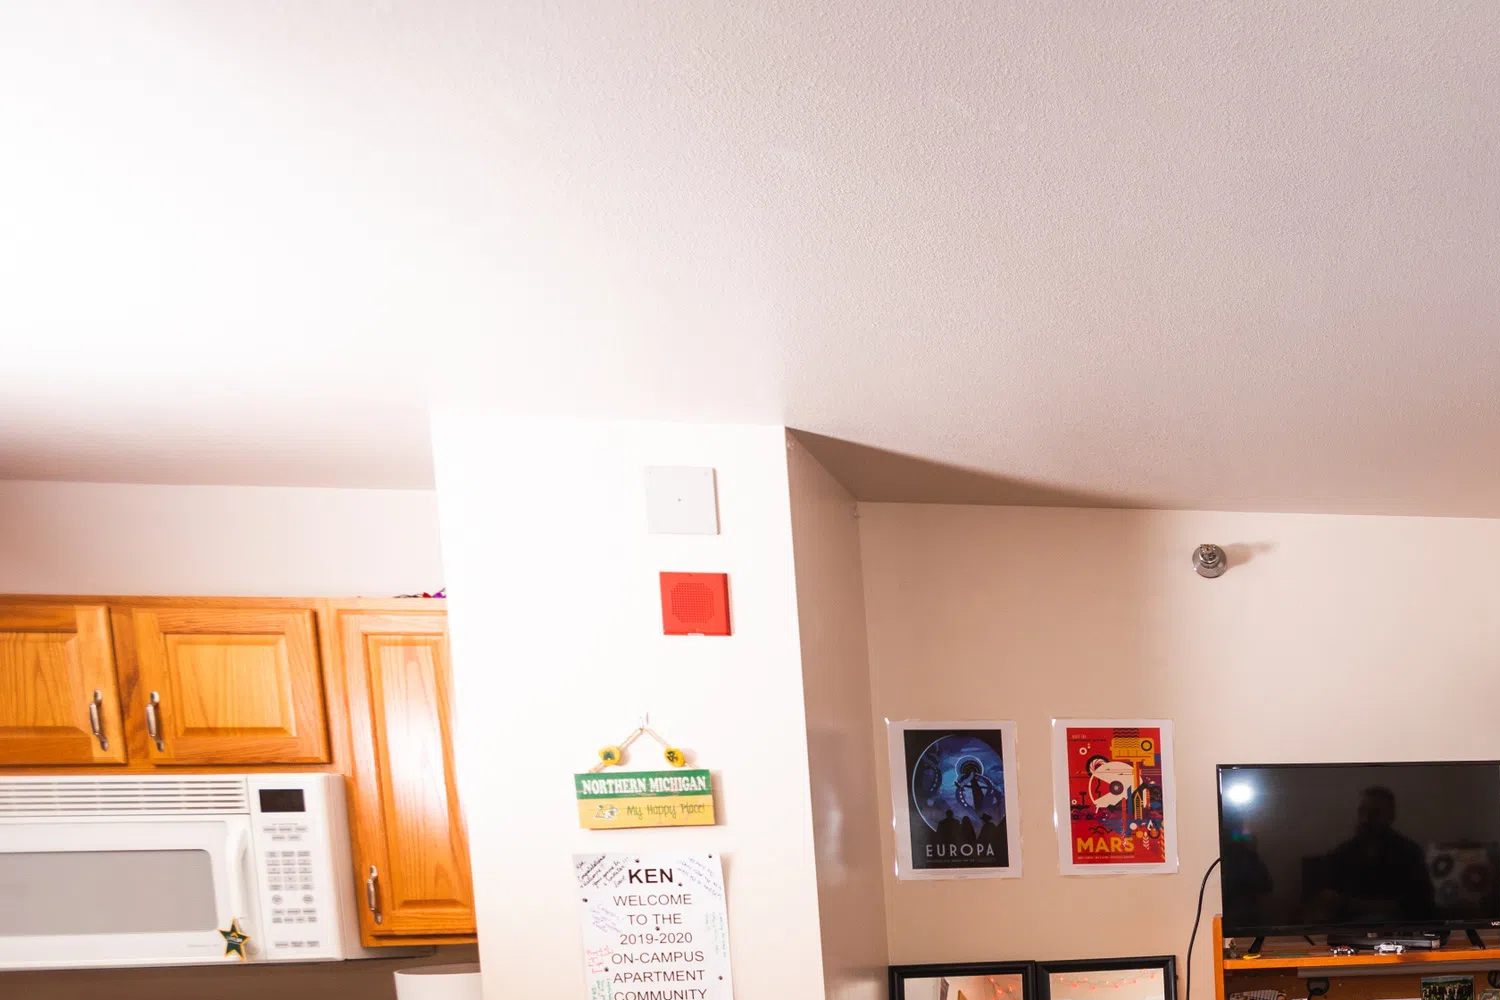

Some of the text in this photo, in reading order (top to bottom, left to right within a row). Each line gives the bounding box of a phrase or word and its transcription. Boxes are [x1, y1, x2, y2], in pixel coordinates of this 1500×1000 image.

[581, 775, 707, 795] NORTHERN MICHIGAN
[626, 802, 706, 821] My Happy Place!
[925, 843, 995, 857] EUROPA
[1076, 836, 1135, 853] MARS
[628, 868, 674, 884] KEN
[613, 893, 692, 906] WELCOME
[627, 913, 648, 926] TO
[652, 913, 683, 925] THE
[620, 931, 693, 946] 2019-2020
[611, 950, 705, 965] ON-CAMPUS
[613, 969, 706, 983] APARTMENT
